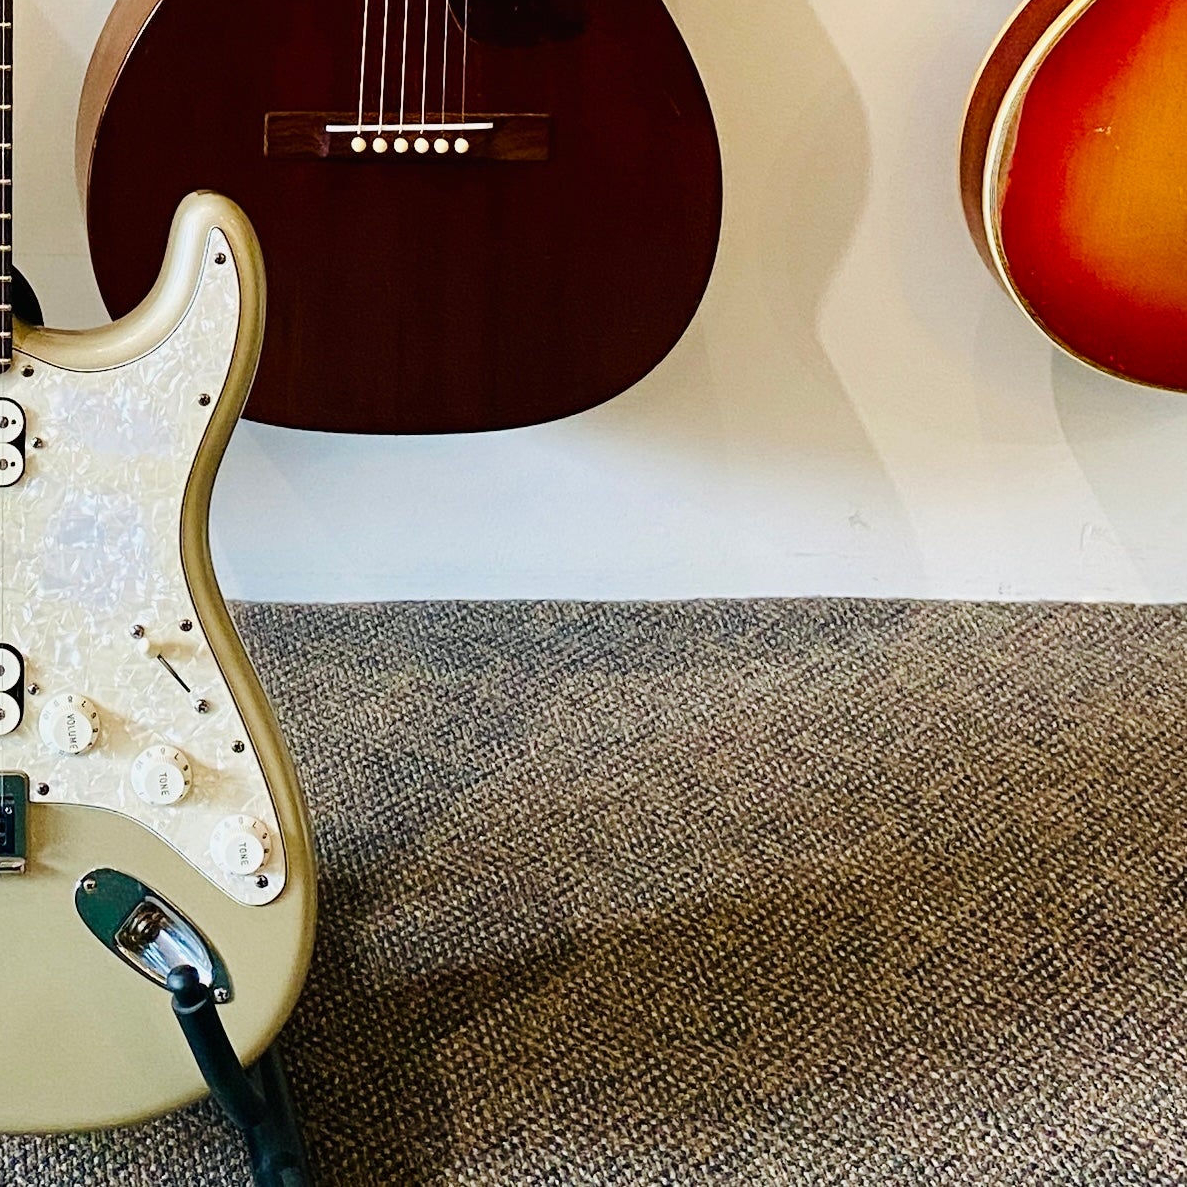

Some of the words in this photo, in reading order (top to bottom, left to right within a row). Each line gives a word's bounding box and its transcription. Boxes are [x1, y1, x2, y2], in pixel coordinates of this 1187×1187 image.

[66, 713, 79, 750] VOLUME
[159, 772, 170, 796] TONE
[238, 842, 249, 866] TONE
